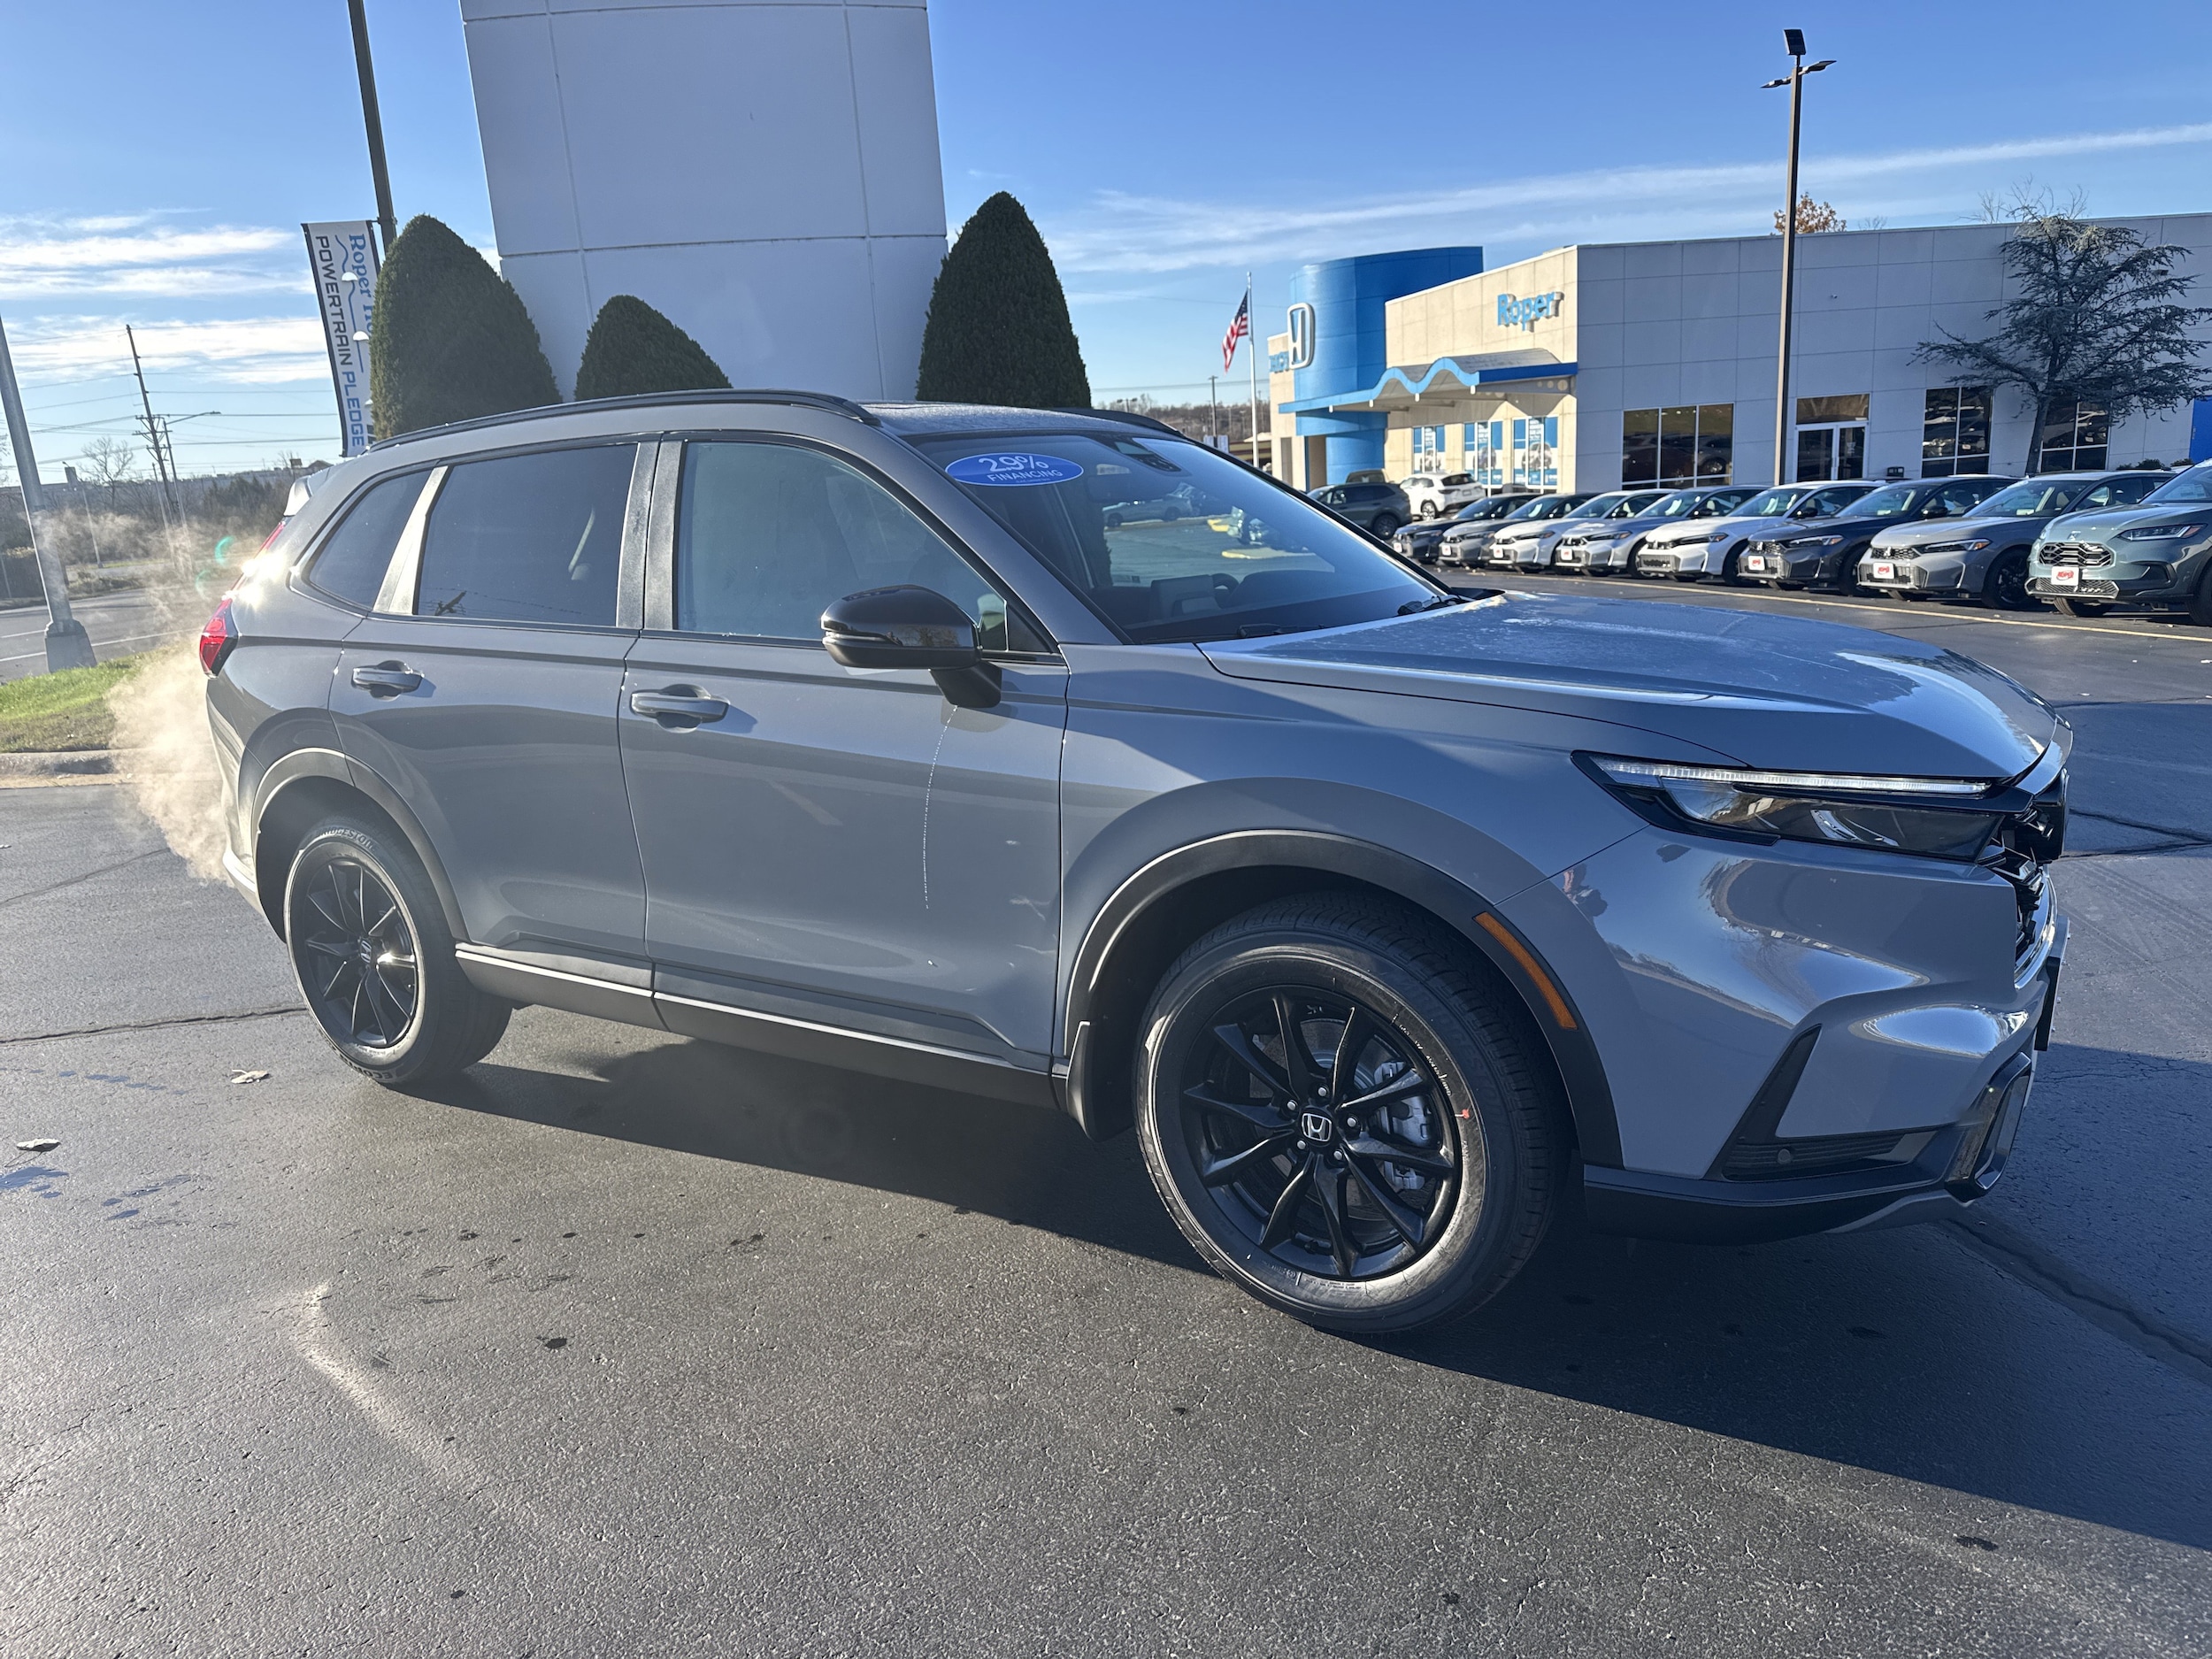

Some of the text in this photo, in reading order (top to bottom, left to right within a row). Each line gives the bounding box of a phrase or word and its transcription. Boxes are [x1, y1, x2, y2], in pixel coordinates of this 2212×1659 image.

[349, 234, 372, 297] Roper
[1497, 291, 1557, 333] Roper
[316, 235, 365, 447] POWERTRAIN PLEDGE
[978, 455, 1049, 472] 2.9%
[987, 468, 1064, 482] FINANCING
